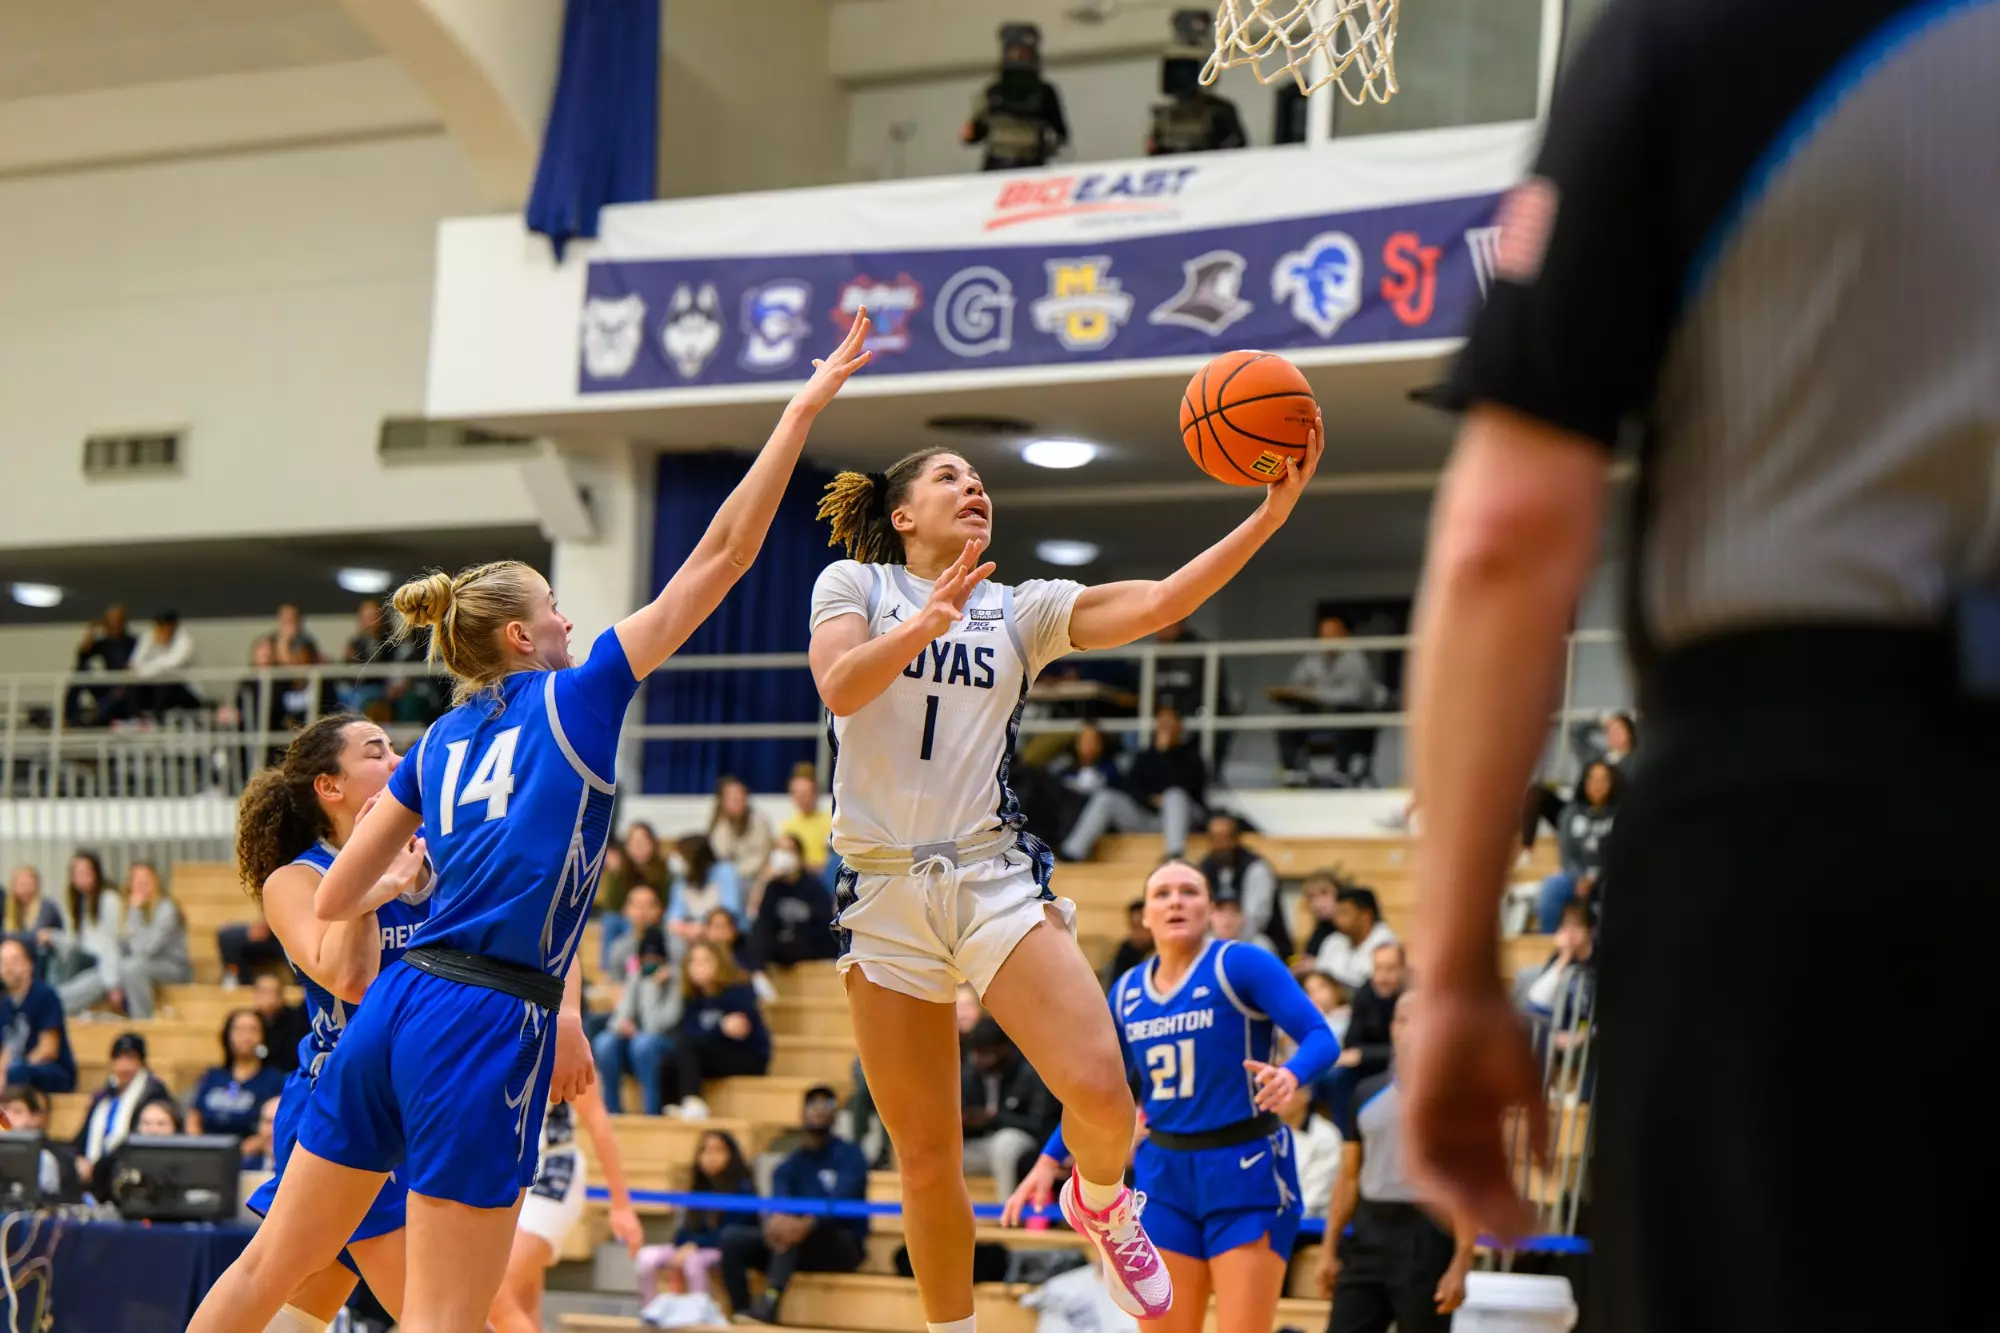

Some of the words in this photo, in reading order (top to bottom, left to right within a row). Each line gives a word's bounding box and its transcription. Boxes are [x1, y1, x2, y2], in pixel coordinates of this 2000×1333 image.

[1074, 166, 1197, 203] EAST
[933, 266, 1016, 357] G
[920, 695, 940, 761] 1
[440, 725, 522, 837] 14
[381, 922, 425, 950] REI
[1125, 1008, 1214, 1043] CREIGHTON
[1146, 1039, 1196, 1101] 21
